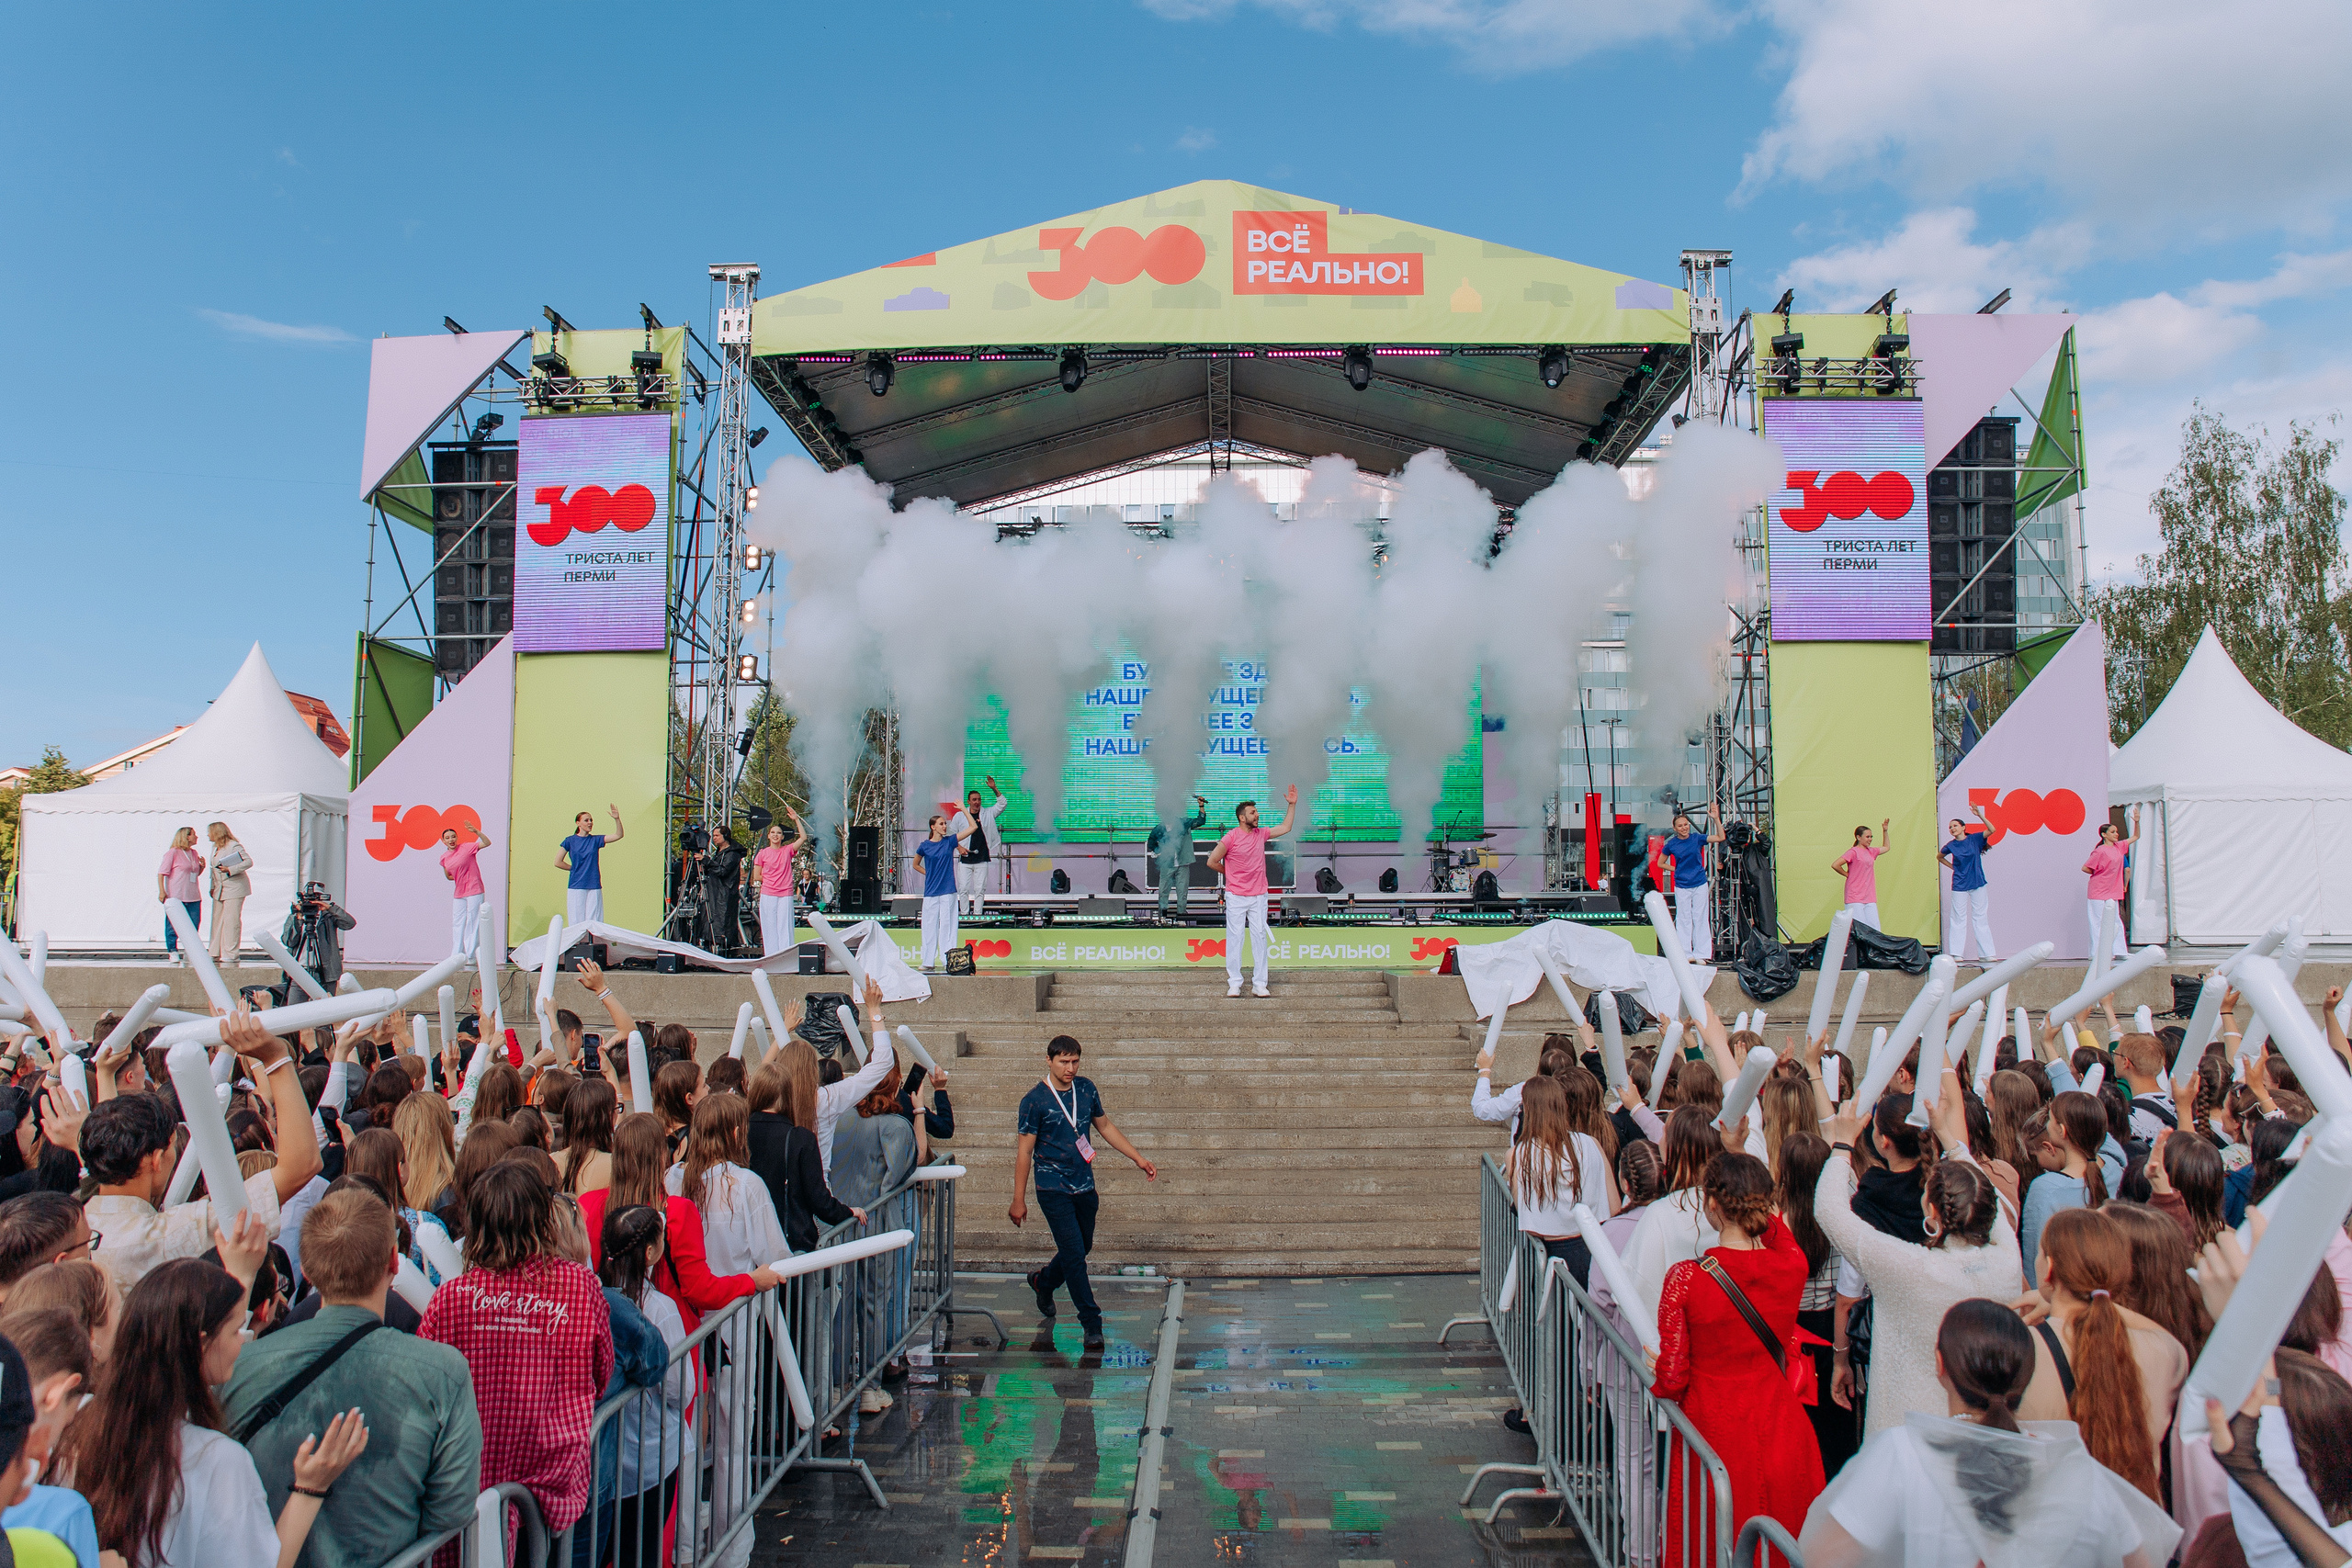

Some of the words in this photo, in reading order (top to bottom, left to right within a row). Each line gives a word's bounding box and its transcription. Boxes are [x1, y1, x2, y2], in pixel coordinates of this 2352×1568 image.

[1247, 223, 1311, 254] ВСЁ
[1027, 224, 1205, 300] 300
[1247, 260, 1409, 285] РЕАЛЬНО!
[526, 483, 657, 547] 300
[1779, 470, 1915, 533] 300
[565, 553, 624, 565] ТРИСТА
[626, 551, 656, 563] ЛЕТ
[1822, 540, 1884, 552] ТРИСТА
[1886, 540, 1917, 552] ЛЕТ
[563, 570, 616, 582] ПЕРМИ
[1822, 558, 1878, 570] ПЕРМИ
[365, 804, 482, 862] 300
[1031, 942, 1067, 961] ВСЁ
[1074, 945, 1166, 961] РЕАЛЬНО!
[1267, 940, 1291, 960] СЁ
[1298, 943, 1390, 960] РЕАЛЬНО!
[472, 1287, 515, 1312] love
[515, 1292, 569, 1335] story
